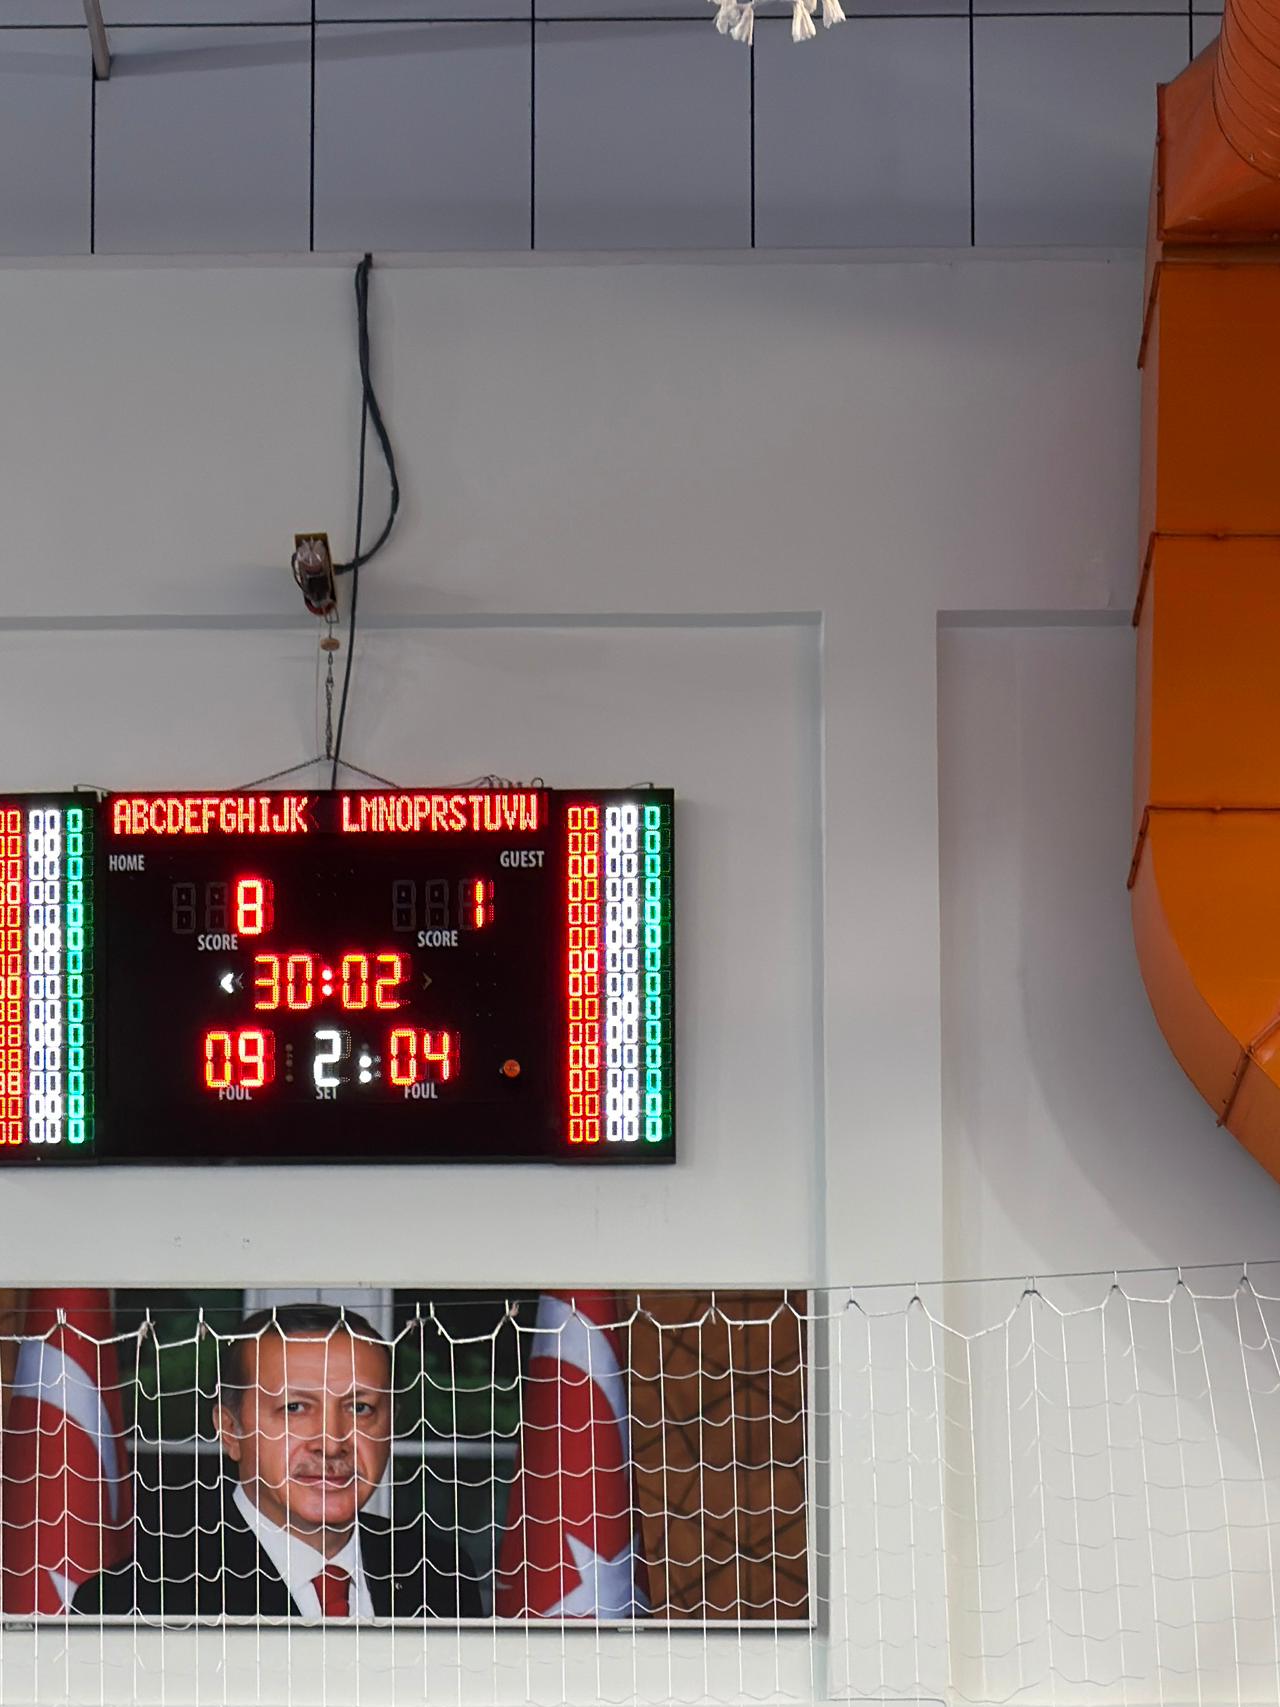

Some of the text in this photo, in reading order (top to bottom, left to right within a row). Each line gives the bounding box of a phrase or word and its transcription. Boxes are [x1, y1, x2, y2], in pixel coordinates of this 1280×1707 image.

[113, 794, 538, 834] ABCDEFGHIJK LMNOPRSTUVW
[109, 854, 145, 872] HOME
[500, 850, 545, 868] GUEST
[237, 879, 263, 935] 8
[475, 880, 484, 928] 1
[197, 934, 238, 951] SCORE
[417, 930, 458, 947] SCORE
[255, 954, 401, 1009] 30:02
[205, 1030, 265, 1088] 09
[313, 1029, 342, 1087] 2
[390, 1028, 450, 1086] 04
[219, 1086, 252, 1101] FOUL
[404, 1083, 438, 1099] FOUL
